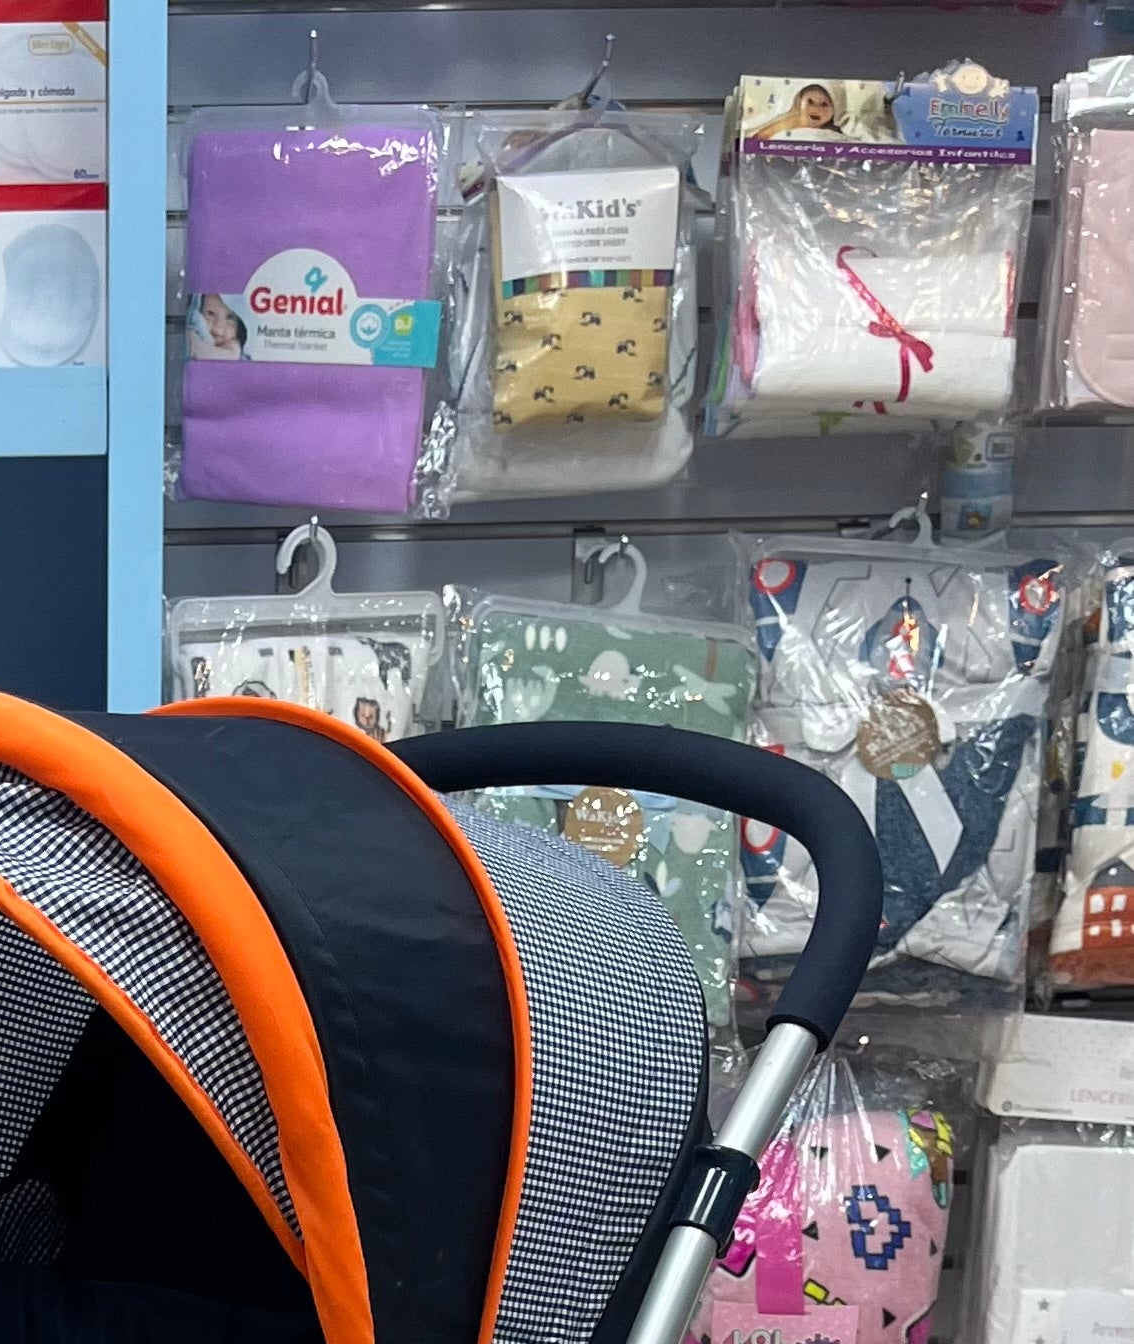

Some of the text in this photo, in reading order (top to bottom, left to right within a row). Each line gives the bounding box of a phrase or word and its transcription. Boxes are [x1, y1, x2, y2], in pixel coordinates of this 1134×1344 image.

[834, 146, 844, 155] y
[249, 286, 344, 317] Genial
[257, 325, 336, 339] Manta térmica
